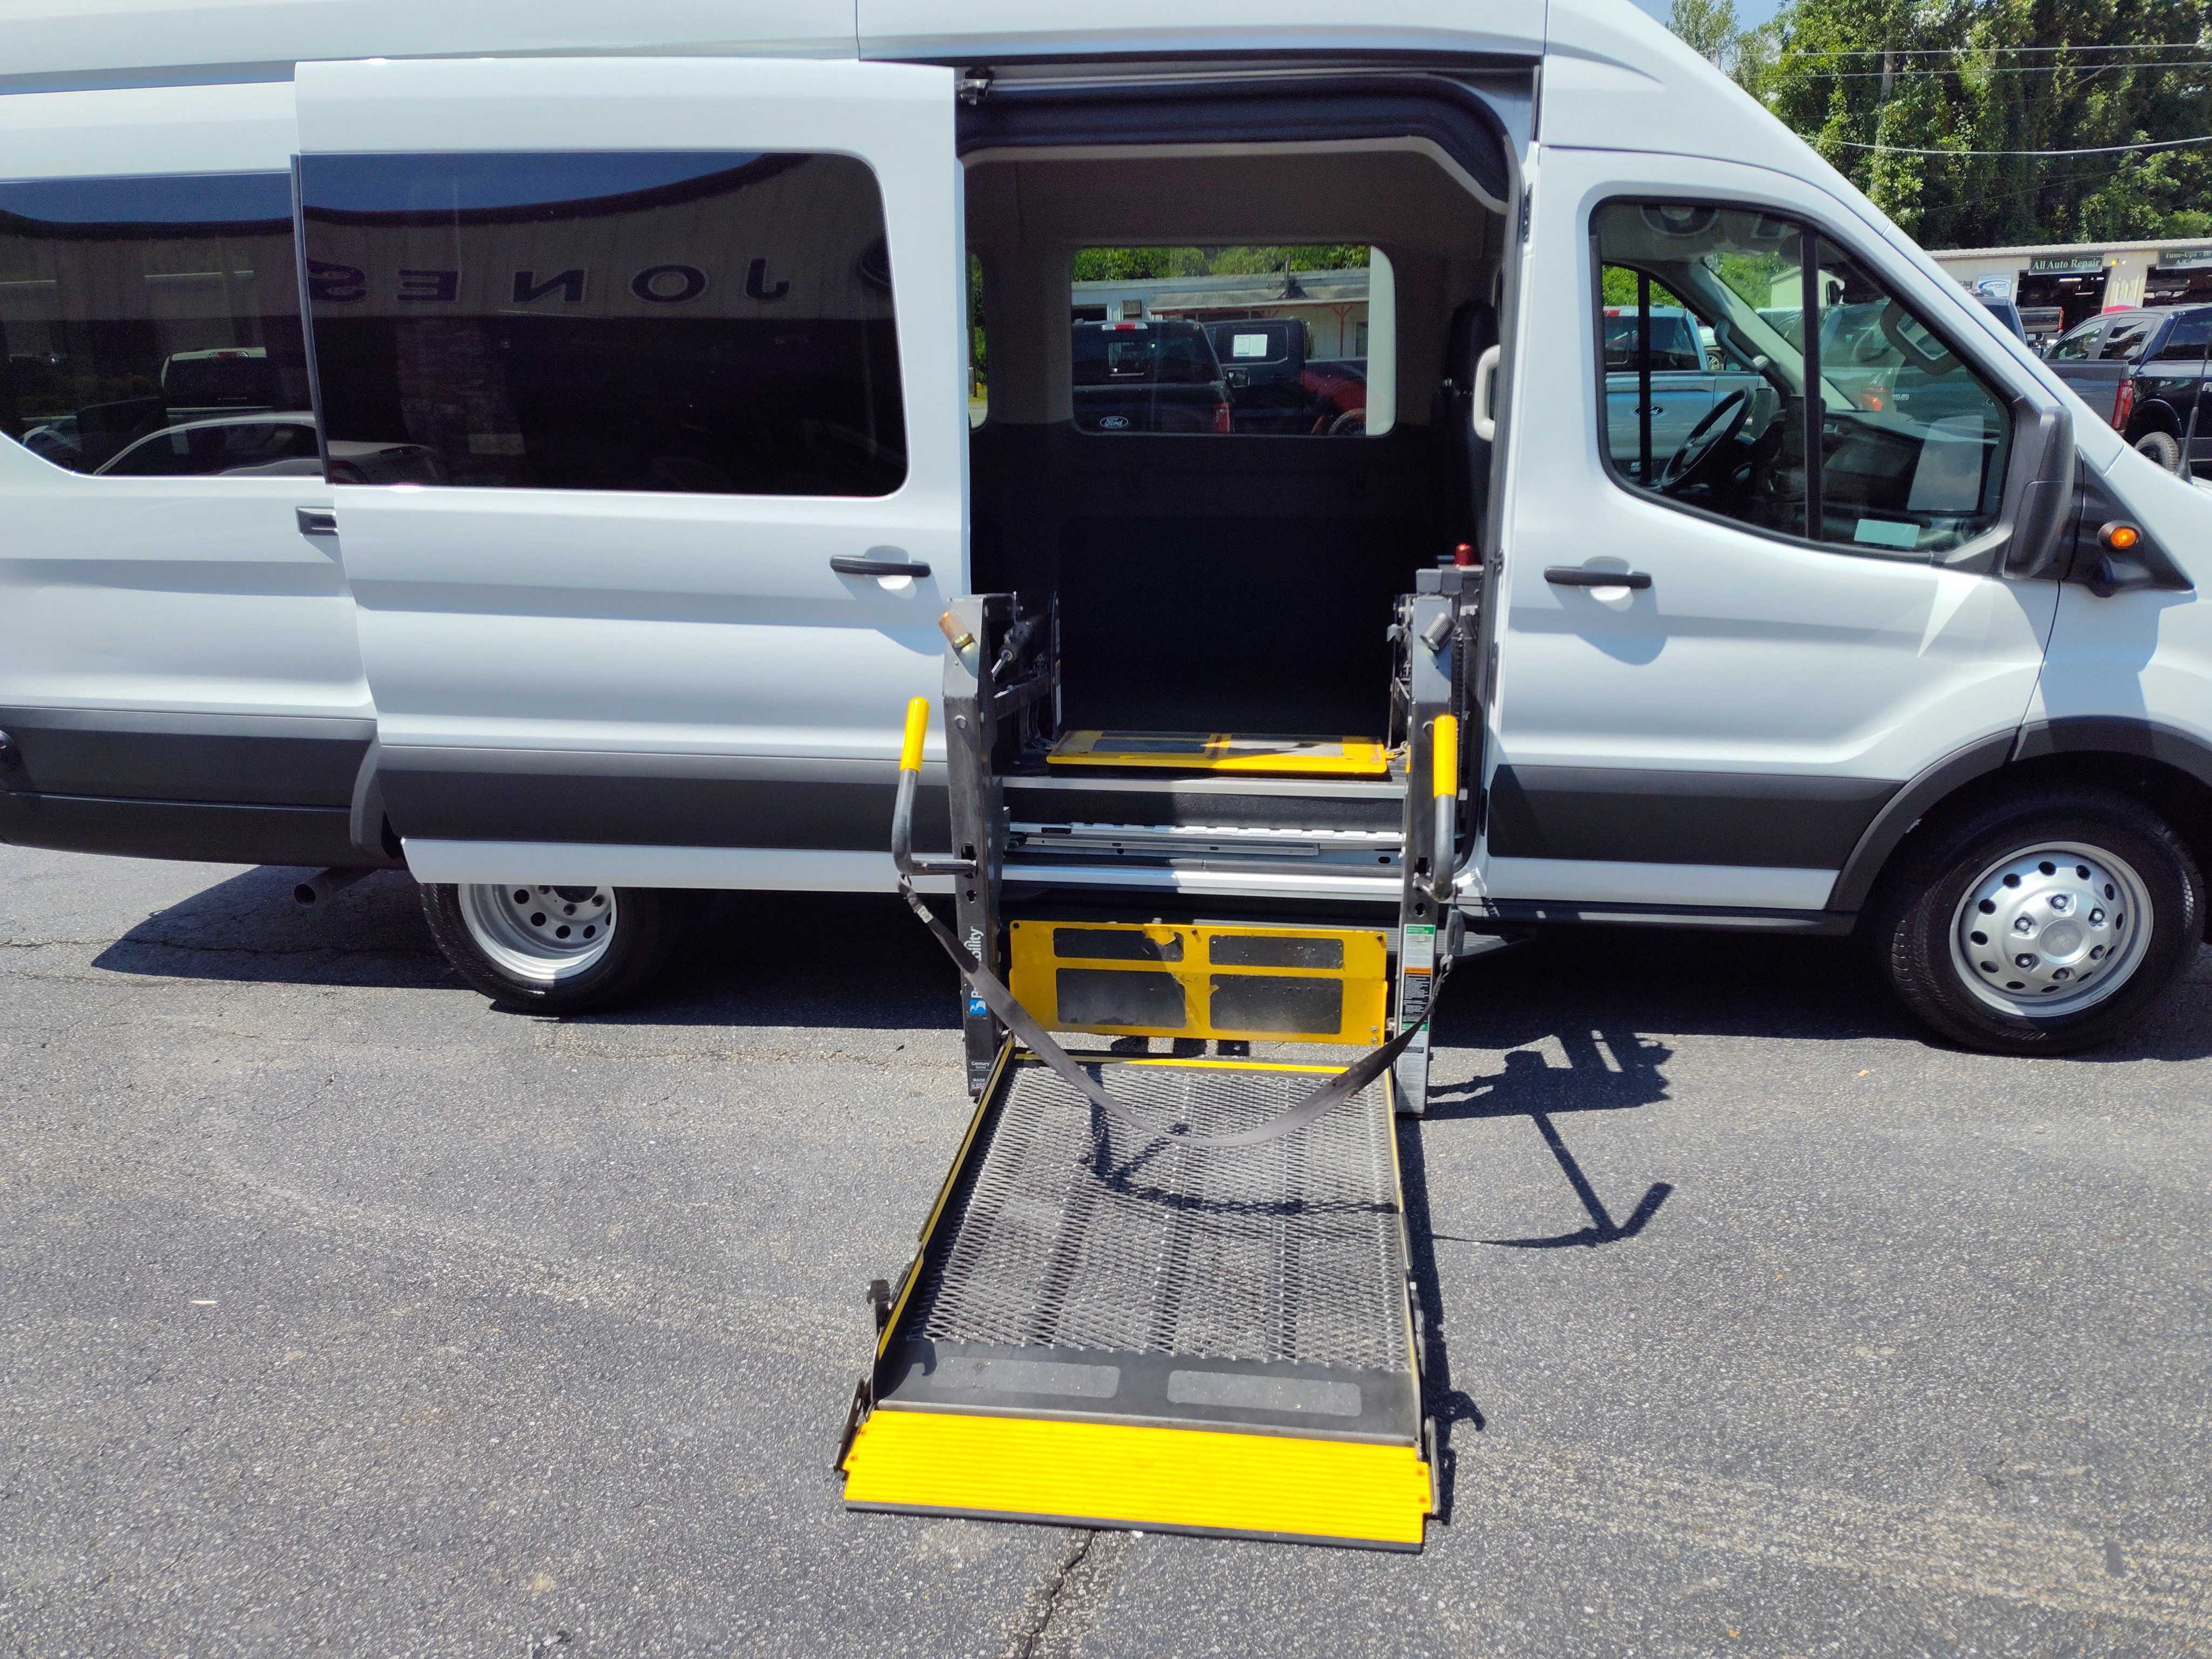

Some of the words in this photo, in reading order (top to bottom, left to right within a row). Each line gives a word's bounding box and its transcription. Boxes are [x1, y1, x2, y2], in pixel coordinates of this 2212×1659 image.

[2032, 260, 2046, 270] All
[2047, 260, 2068, 269] Auto
[2071, 258, 2100, 269] Repair
[1104, 417, 1124, 427] Ford
